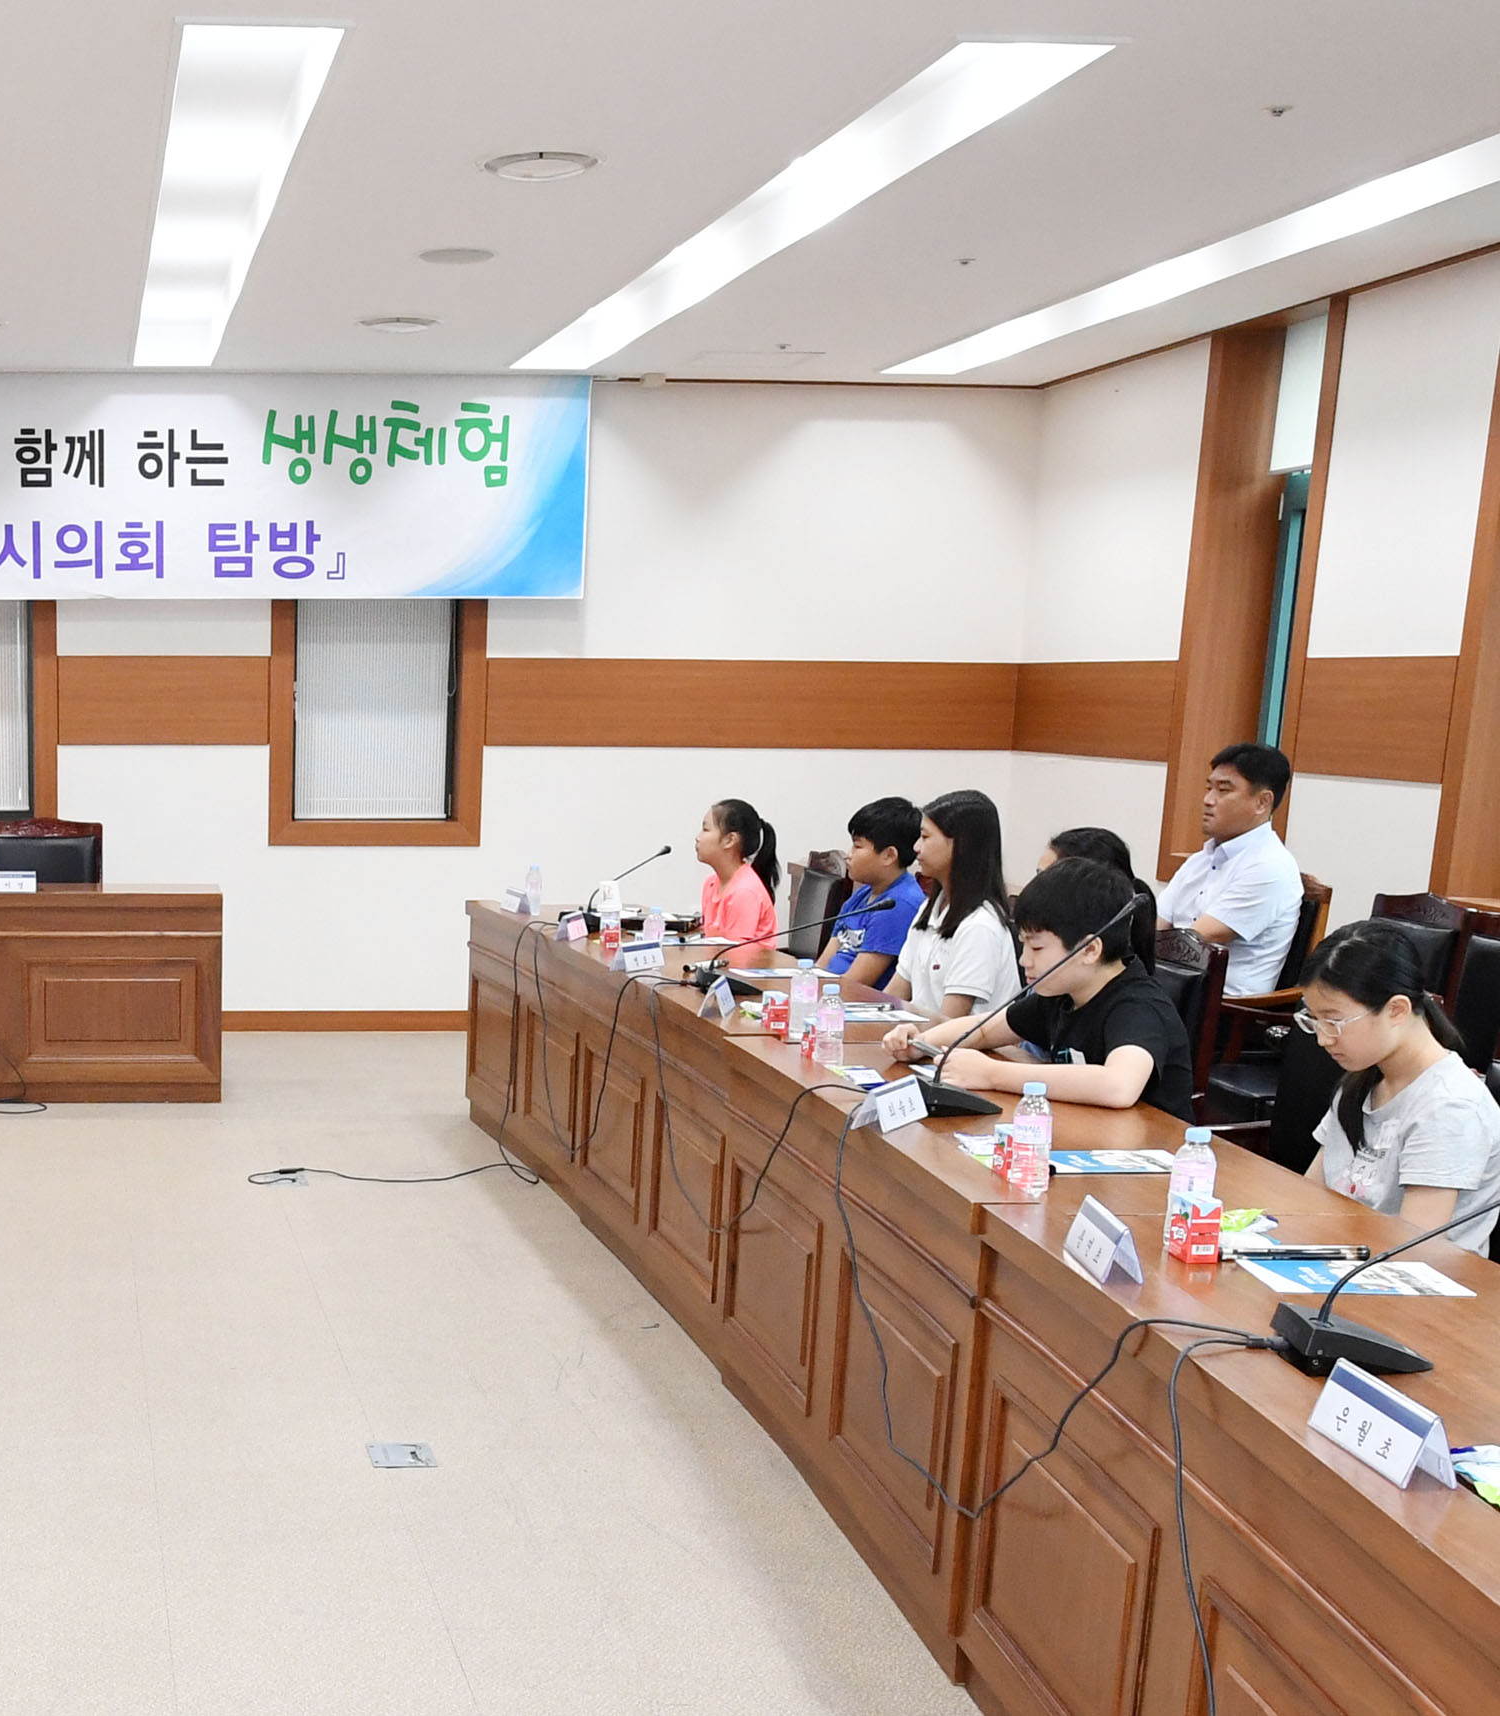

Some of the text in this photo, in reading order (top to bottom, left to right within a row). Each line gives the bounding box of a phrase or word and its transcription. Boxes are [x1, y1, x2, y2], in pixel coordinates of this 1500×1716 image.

[14, 428, 105, 488] 함께
[136, 429, 229, 488] 하는
[261, 400, 511, 488] 생생체험
